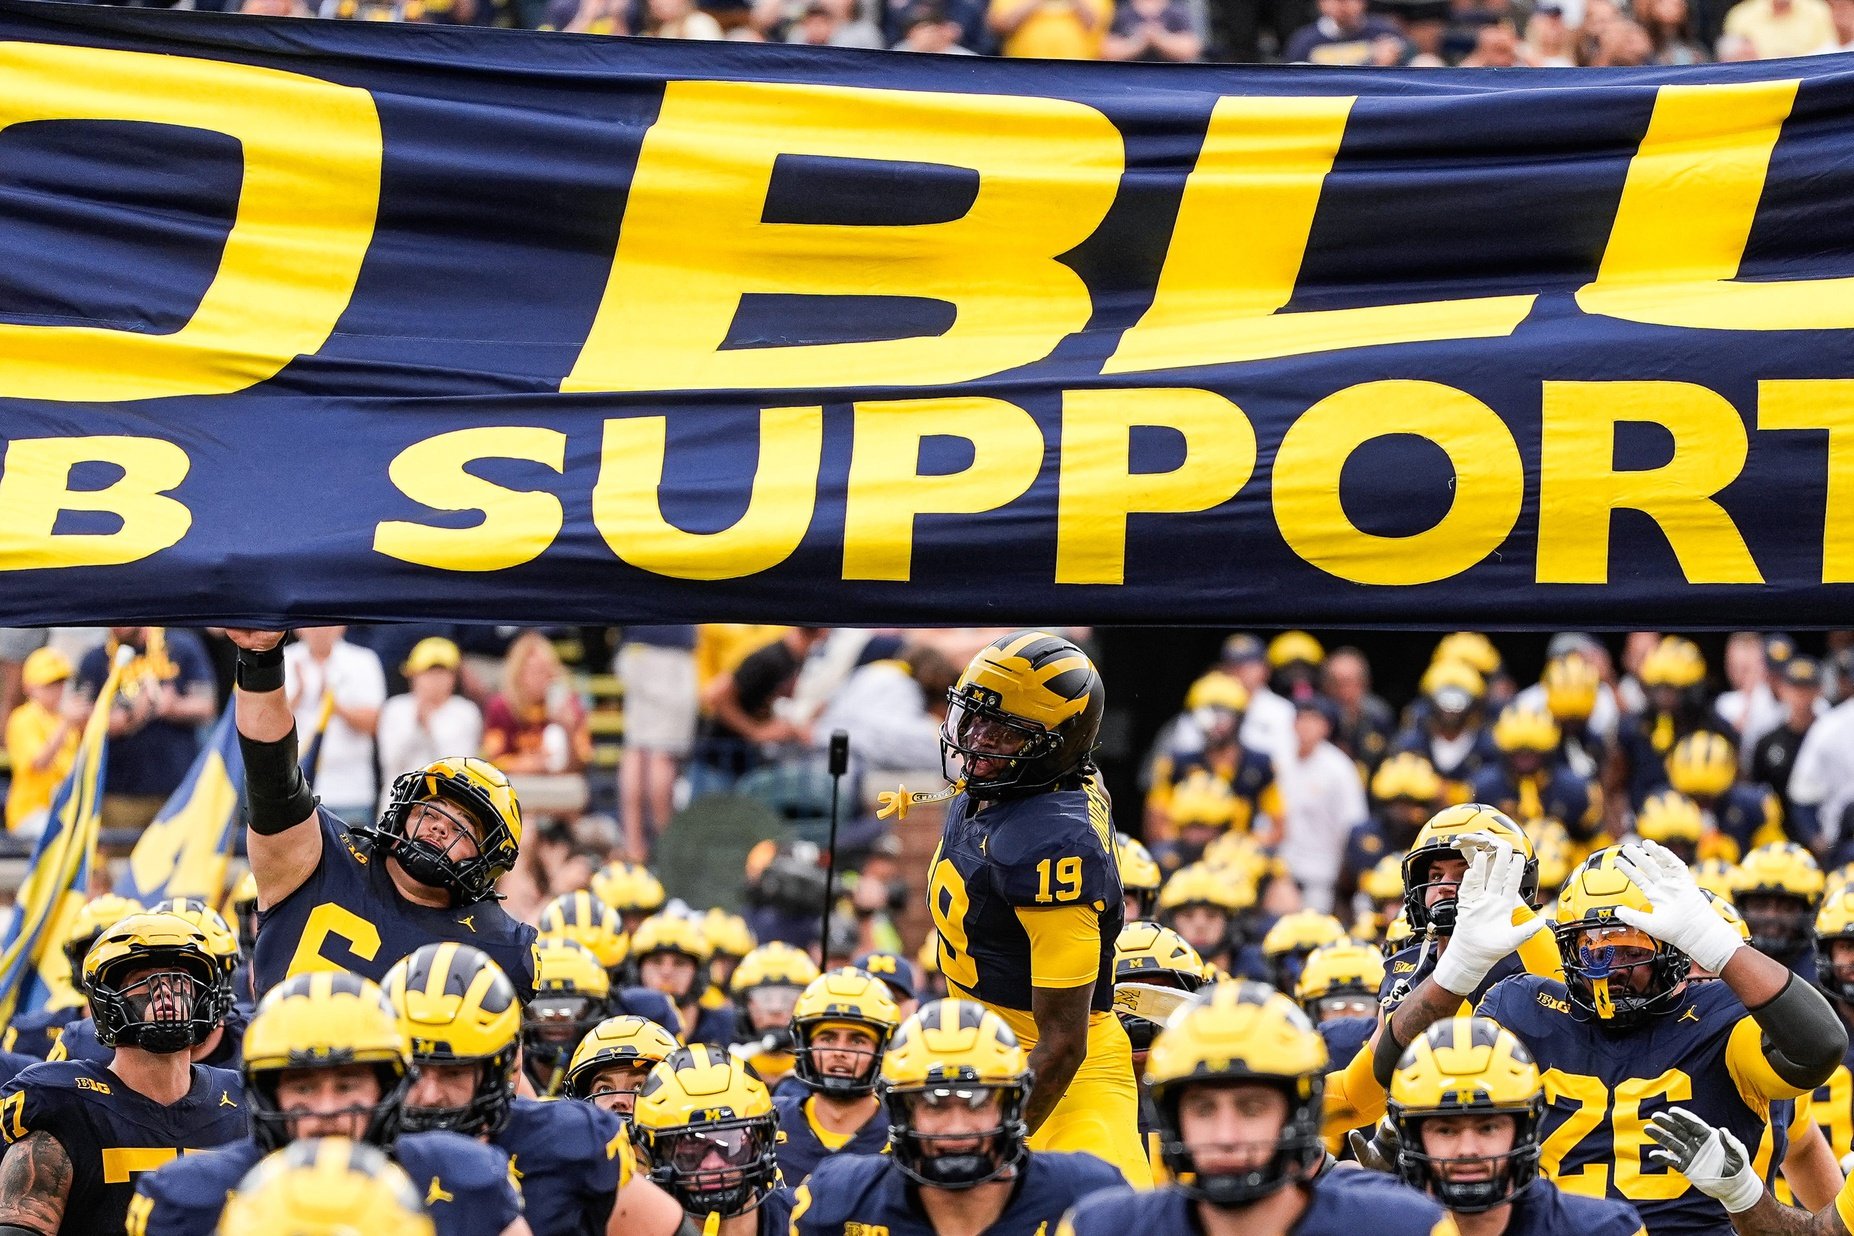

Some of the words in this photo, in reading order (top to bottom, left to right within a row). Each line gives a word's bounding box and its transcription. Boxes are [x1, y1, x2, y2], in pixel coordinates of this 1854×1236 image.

[1035, 856, 1082, 903] 19
[1597, 908, 1613, 919] M
[1129, 958, 1143, 969] M
[704, 1108, 721, 1122] M
[1537, 1066, 1692, 1202] 26
